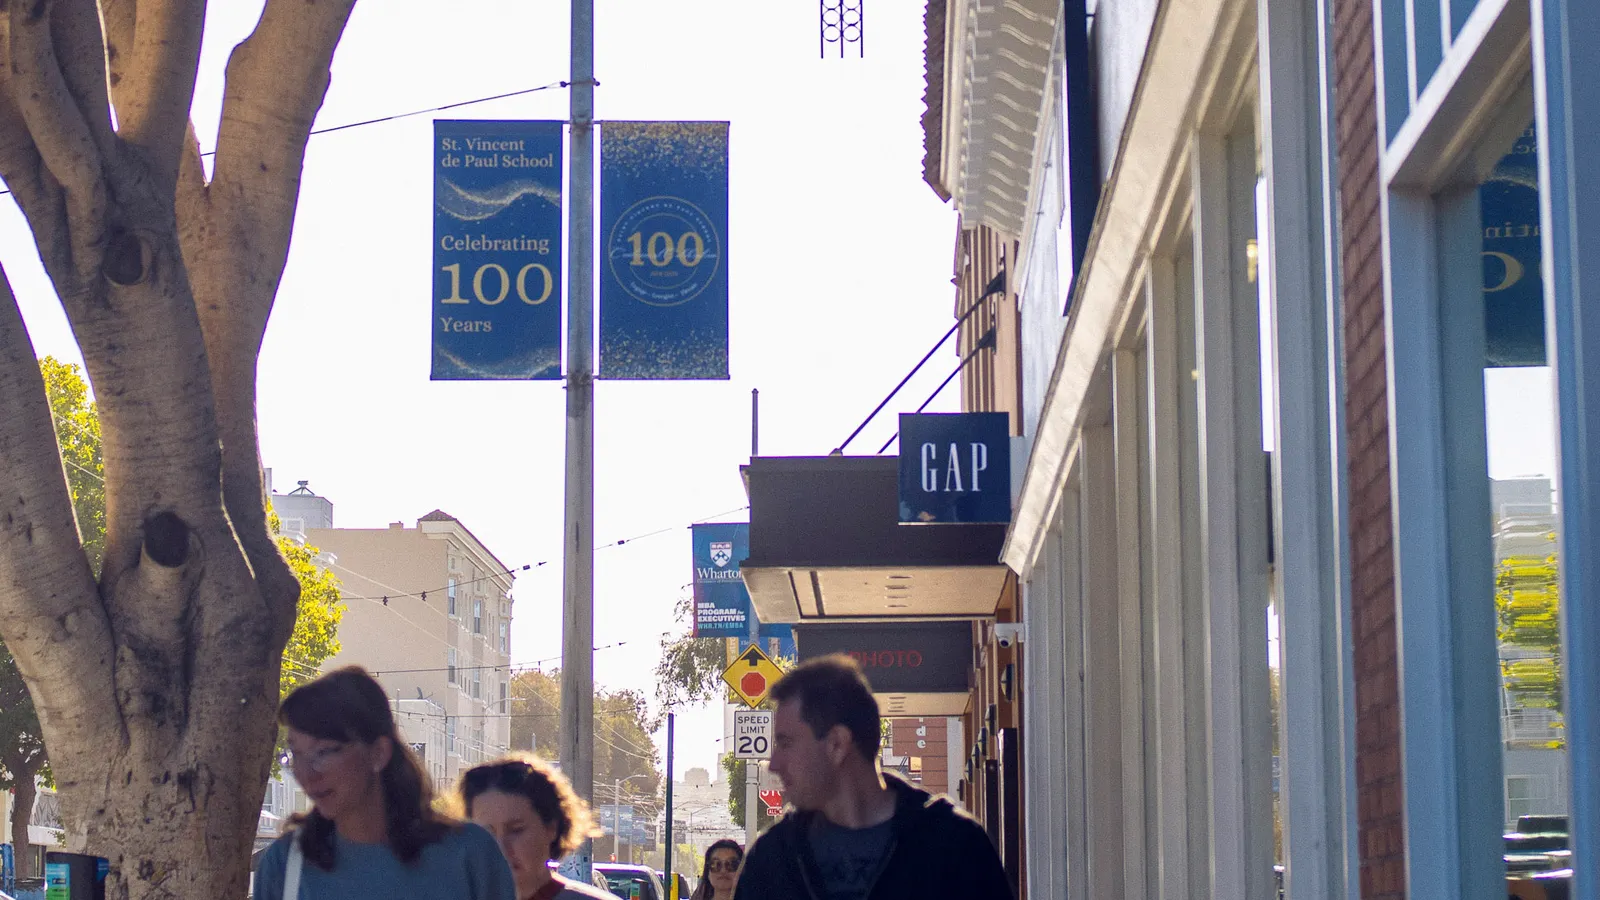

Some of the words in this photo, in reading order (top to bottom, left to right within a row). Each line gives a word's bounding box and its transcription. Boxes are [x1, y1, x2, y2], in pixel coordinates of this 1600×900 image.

[441, 137, 462, 151] St.
[466, 136, 525, 151] Vincent
[441, 153, 460, 168] de
[464, 153, 498, 168] Paul
[502, 153, 554, 168] School
[441, 234, 550, 255] Celebrating
[627, 231, 705, 267] 100
[441, 263, 553, 305] 100
[440, 317, 492, 333] Years
[921, 442, 988, 492] GAP
[698, 615, 746, 623] EXECUTIVES
[737, 716, 770, 724] SPEED
[740, 726, 766, 734] LIMIT
[738, 735, 768, 754] 20
